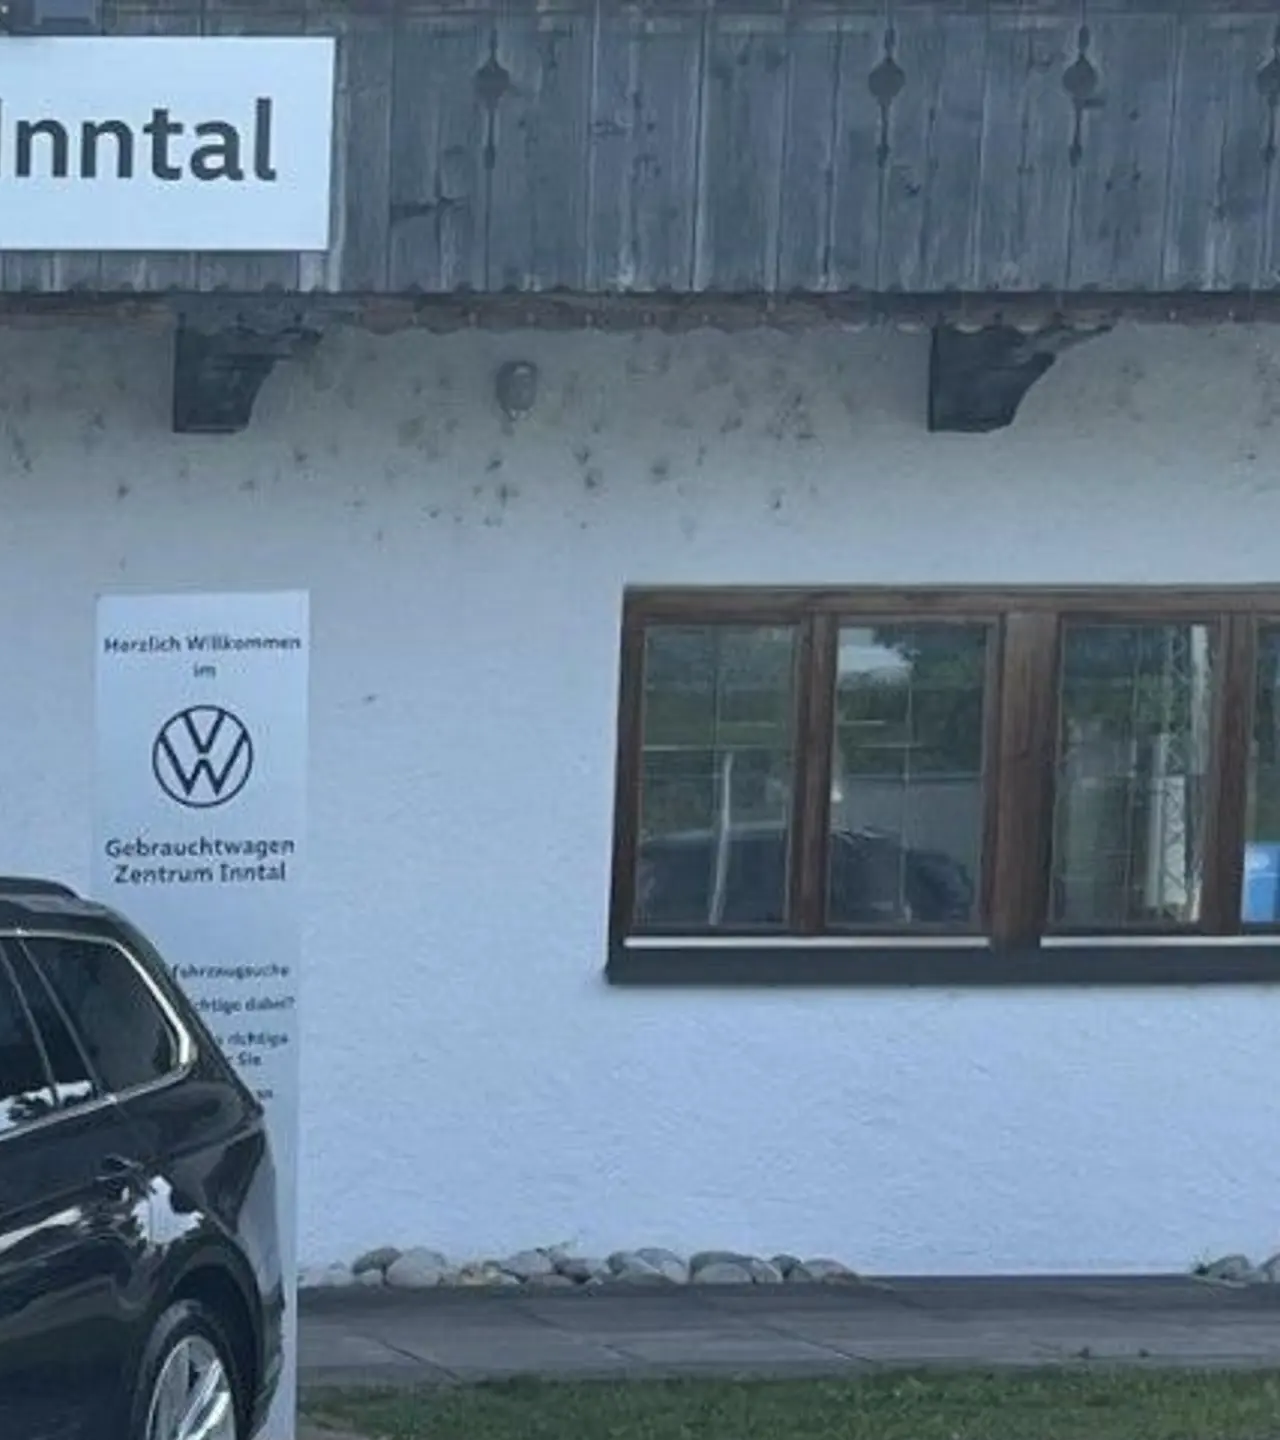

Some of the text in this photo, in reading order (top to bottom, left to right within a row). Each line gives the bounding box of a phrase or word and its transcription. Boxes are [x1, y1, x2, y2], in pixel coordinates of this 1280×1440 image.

[103, 634, 301, 652] Herzlich Willkommen
[194, 663, 217, 678] im
[104, 836, 295, 859] Gebrauchtwagen
[114, 861, 286, 884] Zentrum Inntal
[173, 962, 290, 980] fahrzeugsuche
